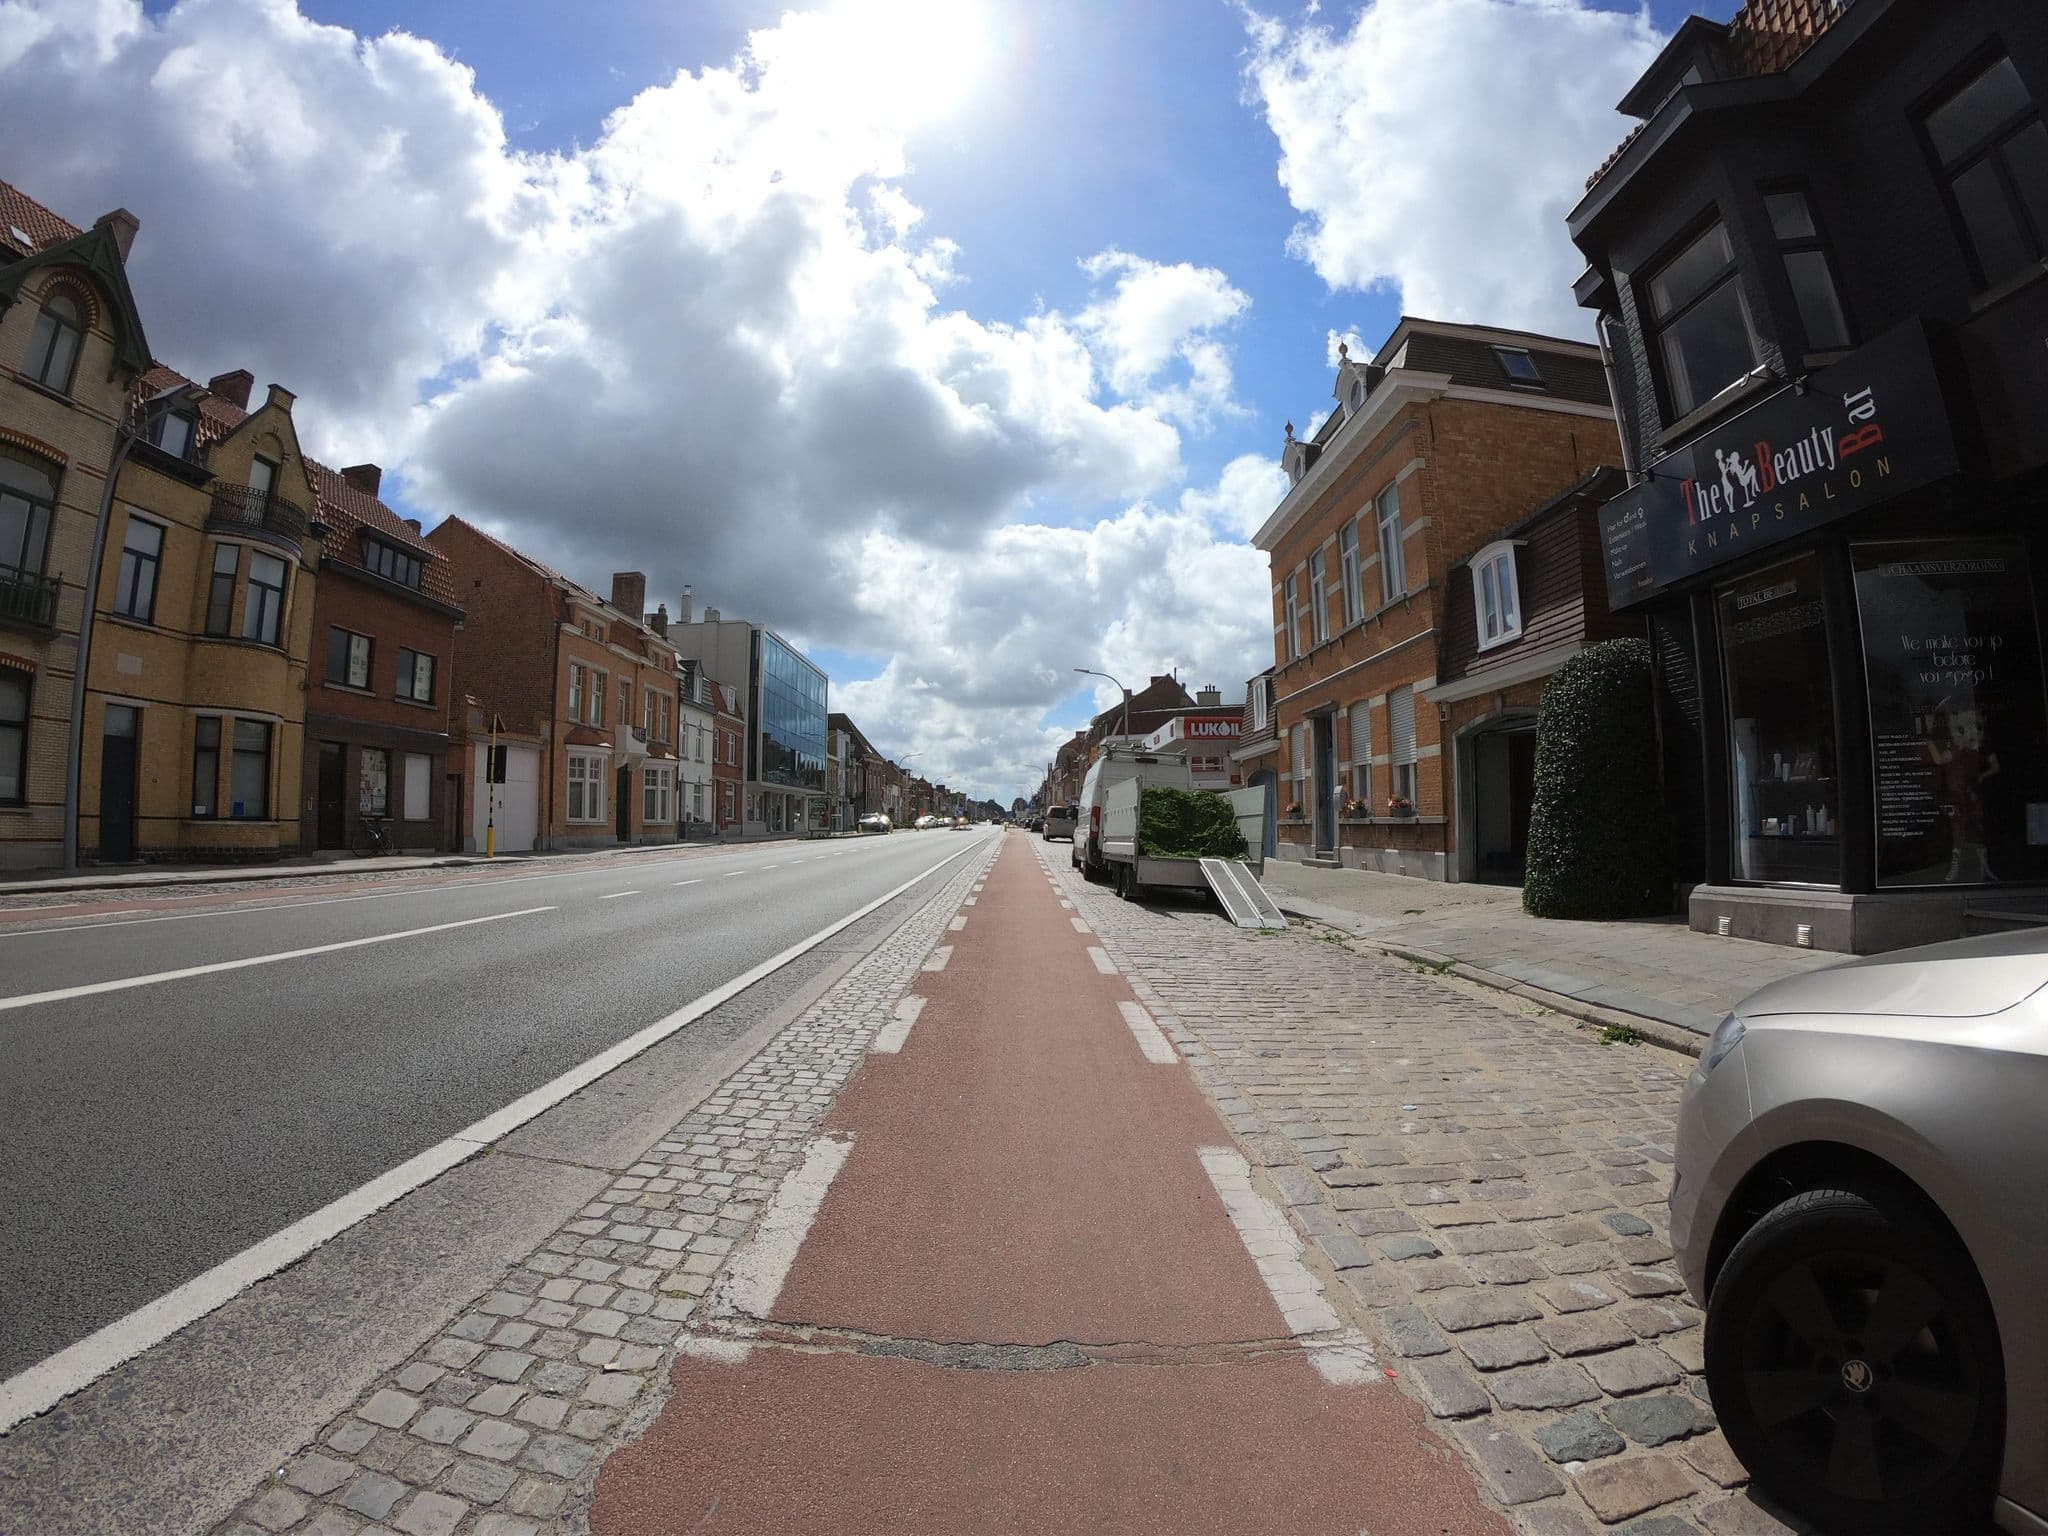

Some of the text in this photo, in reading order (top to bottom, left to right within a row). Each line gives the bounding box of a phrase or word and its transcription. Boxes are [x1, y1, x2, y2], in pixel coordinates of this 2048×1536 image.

[1680, 385, 1885, 526] The Beauty Bar
[1687, 455, 1891, 557] KNAPSALON
[1933, 651, 1976, 667] before
[1190, 721, 1242, 736] LUKOIL
